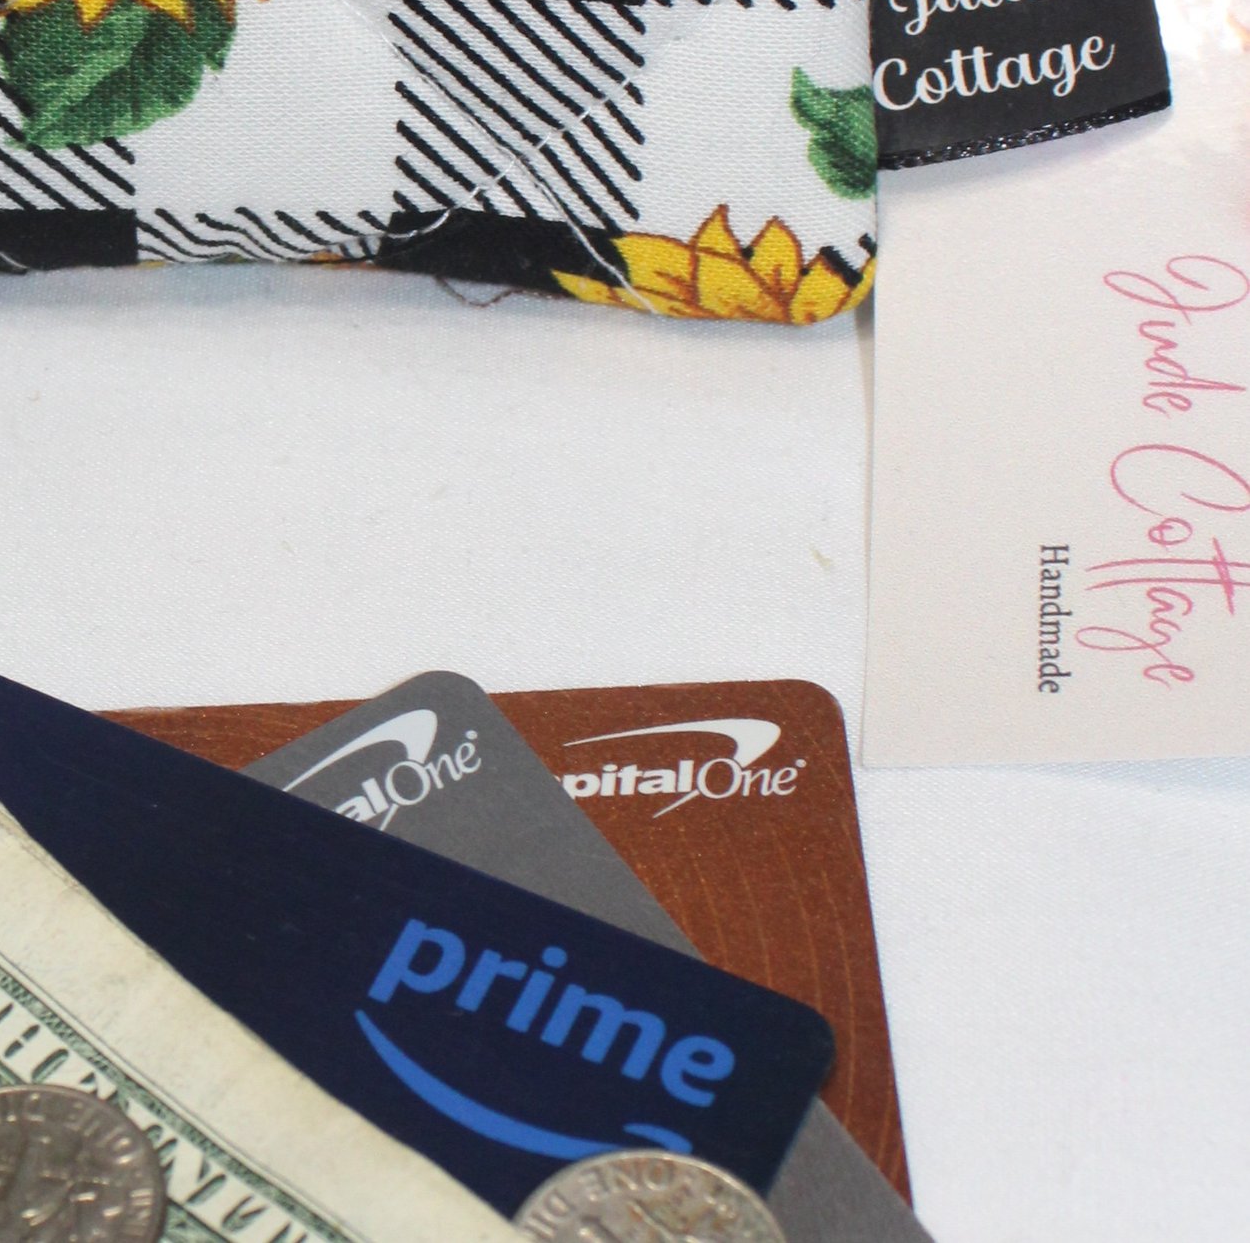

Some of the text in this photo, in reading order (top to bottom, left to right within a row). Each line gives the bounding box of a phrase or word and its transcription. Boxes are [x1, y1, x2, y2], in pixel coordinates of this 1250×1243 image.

[872, 35, 1116, 111] Cottage
[1074, 254, 1250, 690] Jude Cottage
[1037, 544, 1072, 694] Handmade
[334, 741, 482, 823] alOne
[554, 757, 799, 800] pitalOne
[367, 917, 735, 1108] prime
